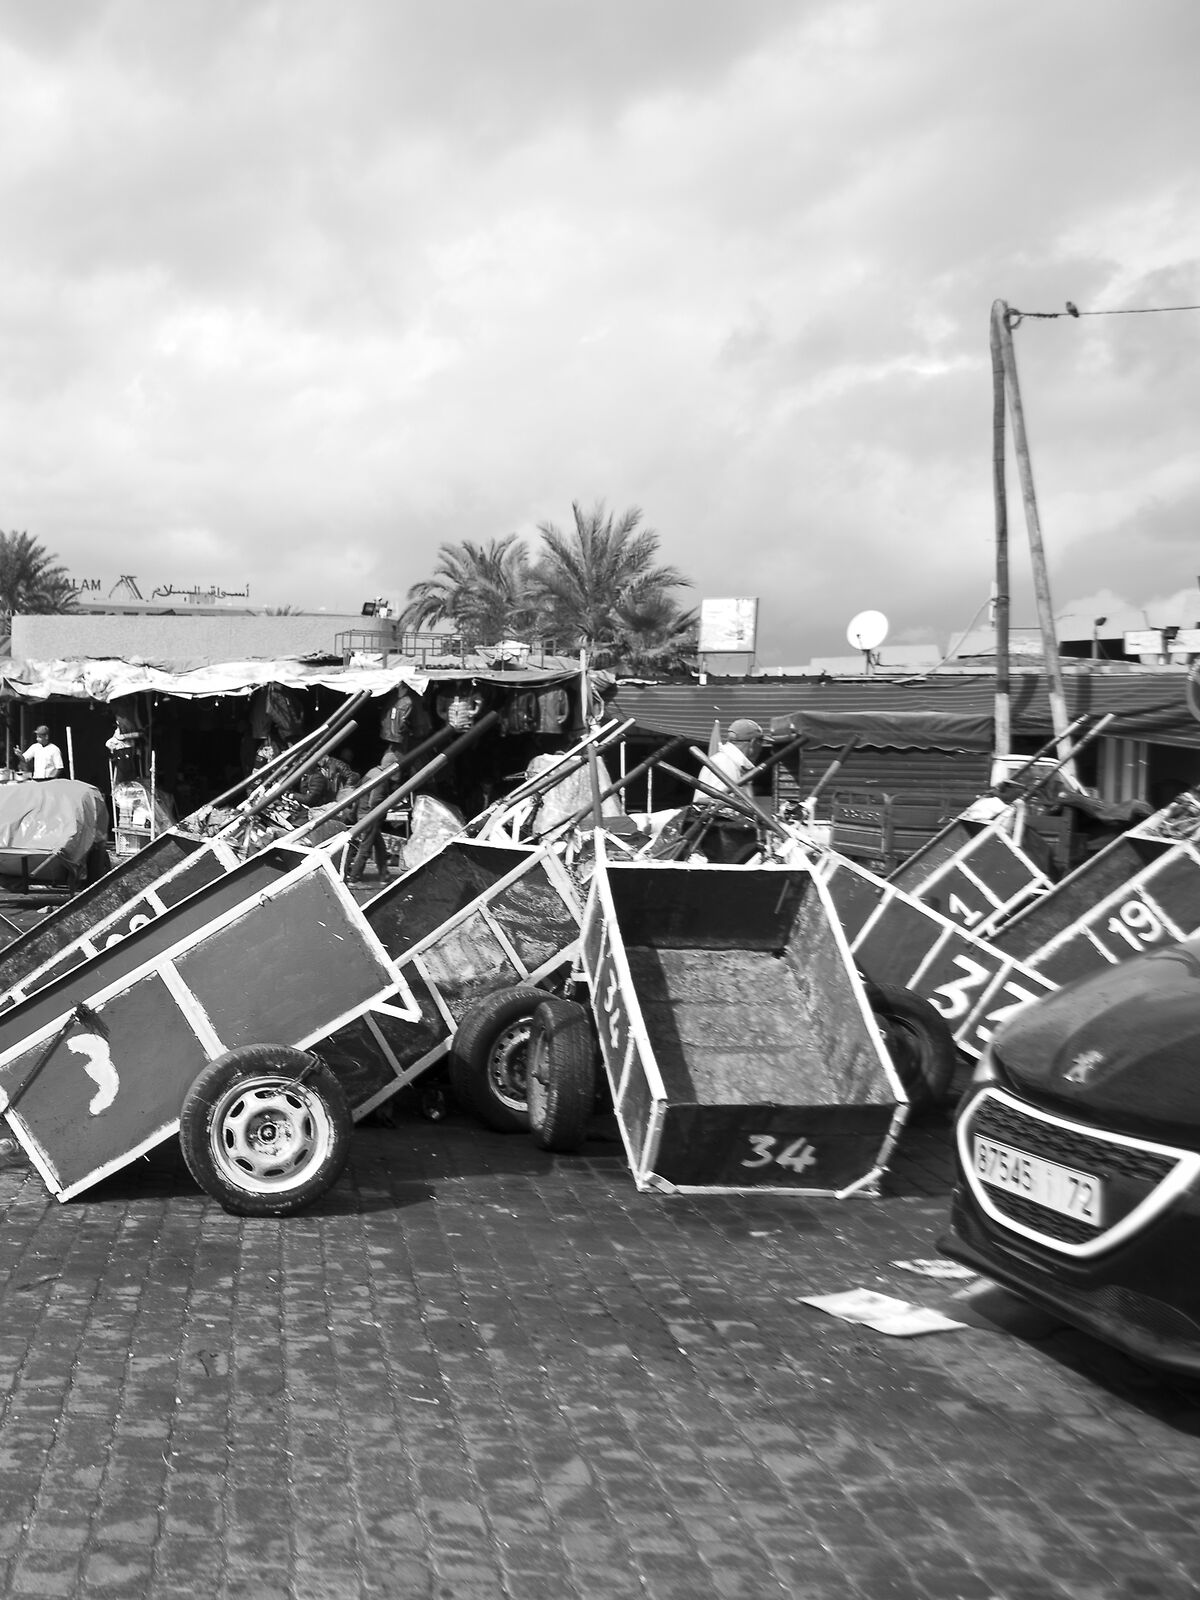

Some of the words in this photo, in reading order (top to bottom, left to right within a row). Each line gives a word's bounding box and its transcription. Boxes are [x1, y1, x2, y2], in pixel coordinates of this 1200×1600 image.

[63, 579, 101, 592] ALAM
[949, 893, 984, 927] 1
[1107, 900, 1162, 952] 19
[65, 1033, 120, 1115] 3
[741, 1134, 817, 1173] 34
[1067, 1176, 1093, 1217] 72
